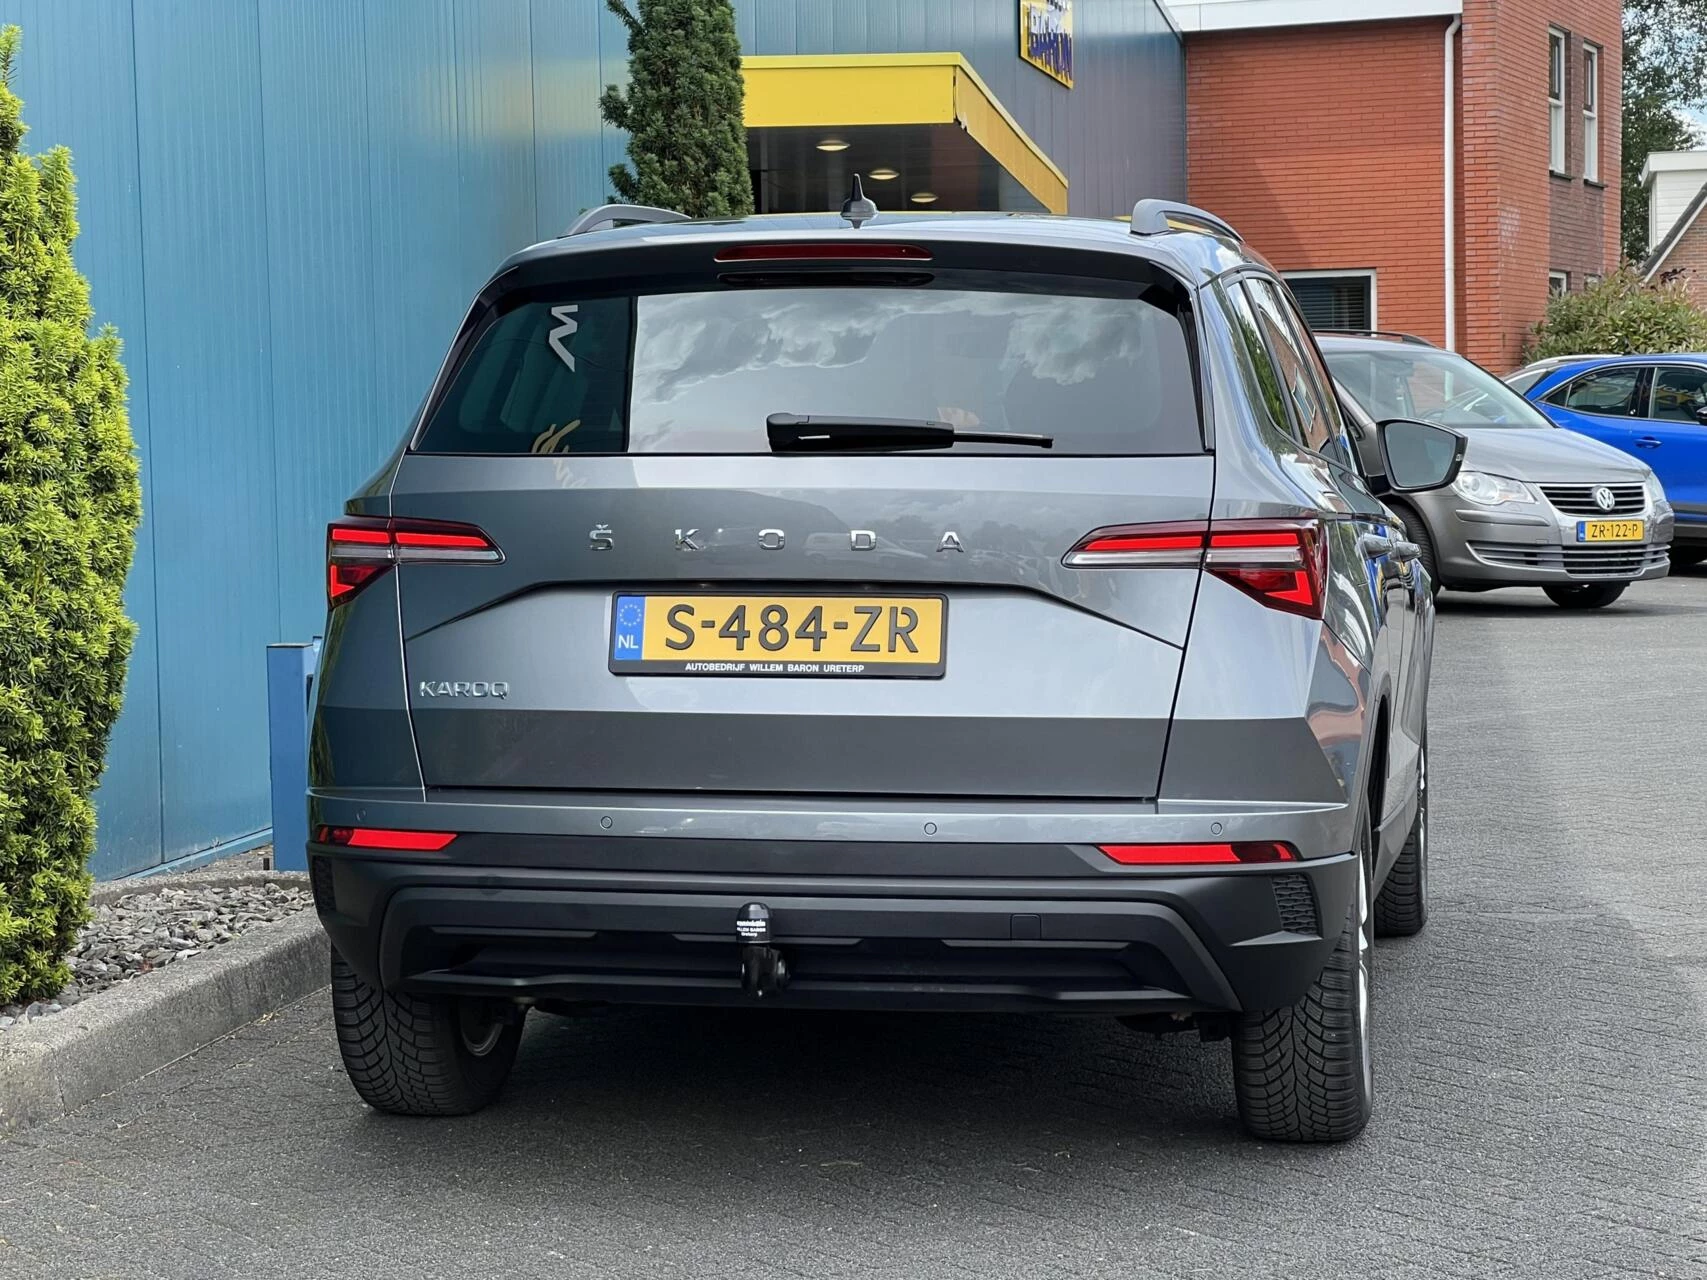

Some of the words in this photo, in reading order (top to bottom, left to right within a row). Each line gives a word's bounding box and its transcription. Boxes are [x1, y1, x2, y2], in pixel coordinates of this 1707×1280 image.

[1591, 523, 1638, 538] ZR-122-P
[665, 603, 919, 653] S-484-ZR
[617, 635, 640, 650] NL
[685, 662, 746, 672] AUTOBEDRIJF
[749, 663, 784, 672] WILLEM
[787, 664, 820, 673] BARON
[823, 664, 865, 673] URETERP
[419, 680, 509, 700] KAROQ
